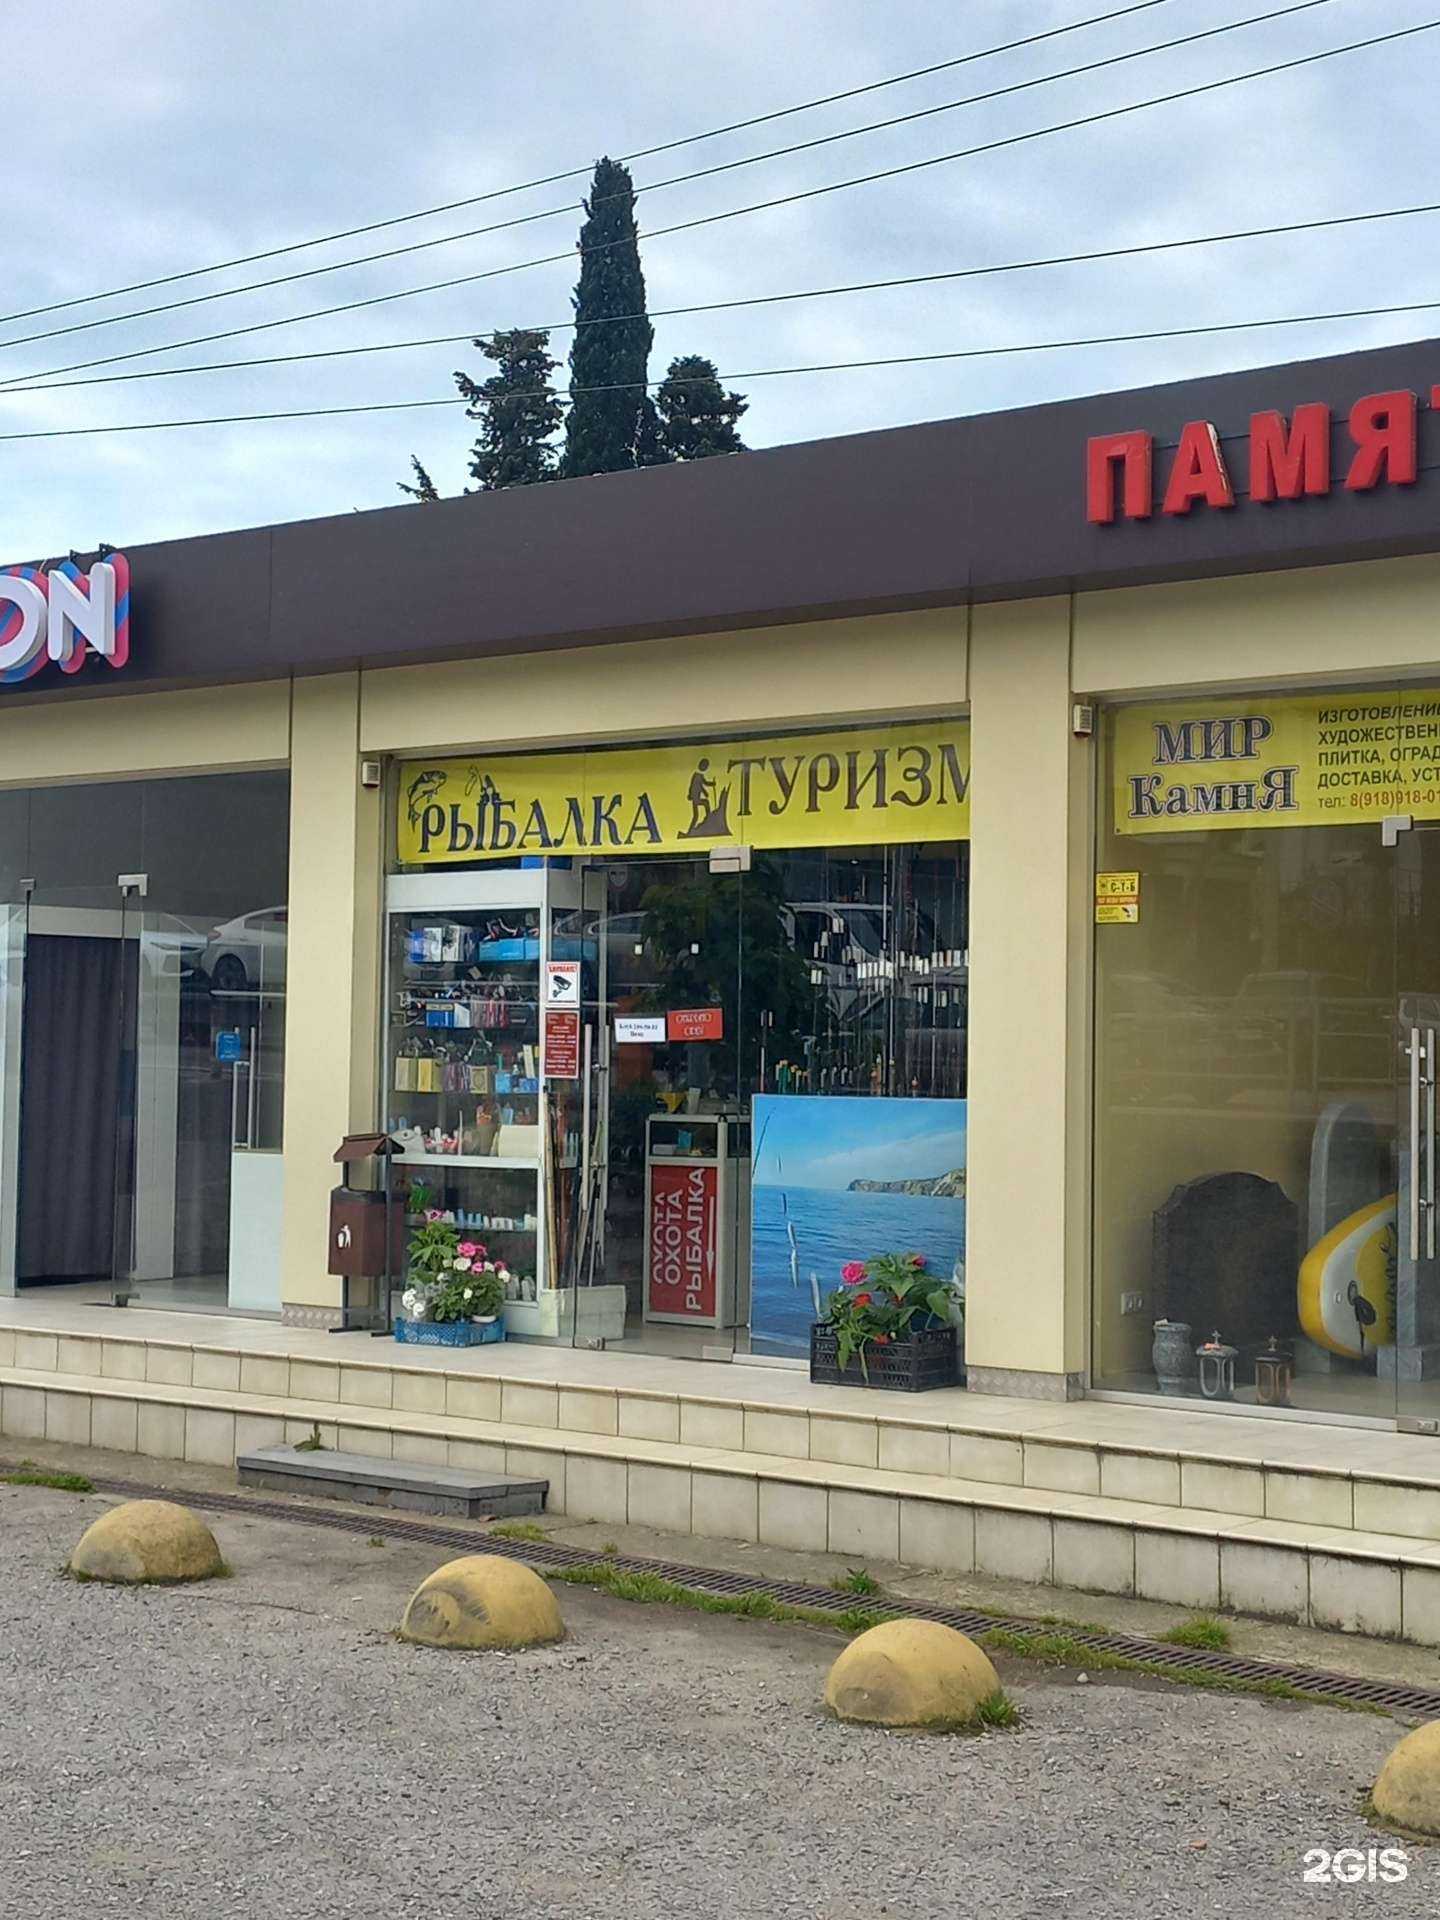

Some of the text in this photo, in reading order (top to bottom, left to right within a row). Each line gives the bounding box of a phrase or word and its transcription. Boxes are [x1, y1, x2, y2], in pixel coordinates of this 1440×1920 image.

[1087, 385, 1440, 524] ПАМЯ
[1153, 715, 1273, 764] МИР
[1318, 749, 1385, 766] ПЛИТКА,
[418, 744, 970, 853] РЫБАЛКА ТУРИЗМ
[1317, 769, 1407, 790] ДОСТАВКА,
[1318, 796, 1345, 809] тел:
[665, 1189, 683, 1285] ОХОТА
[686, 1168, 706, 1311] РЫБАЛКА
